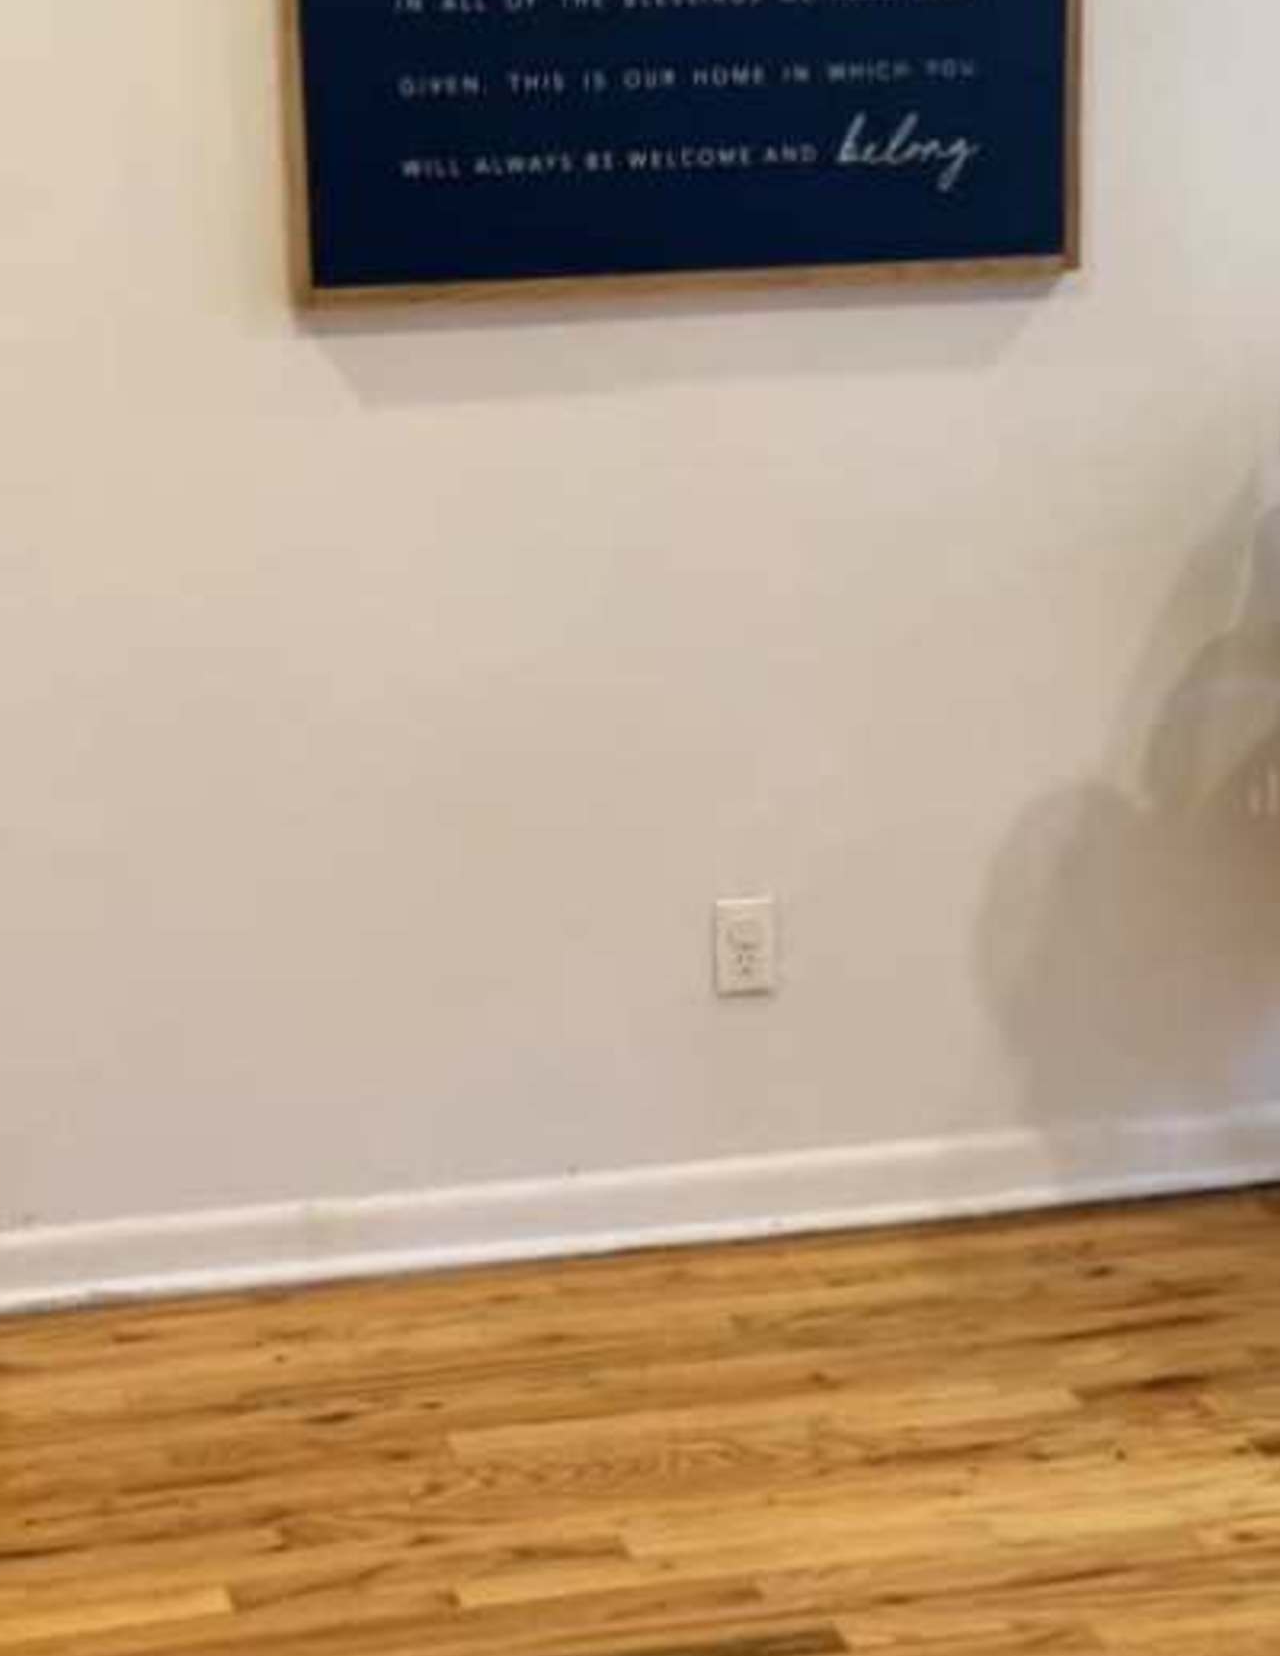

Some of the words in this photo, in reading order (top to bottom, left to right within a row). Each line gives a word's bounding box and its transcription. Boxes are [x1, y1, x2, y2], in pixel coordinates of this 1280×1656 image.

[508, 70, 565, 93] THIS
[582, 70, 607, 92] IS
[623, 68, 676, 90] OUR
[692, 65, 765, 87] HOME
[782, 64, 810, 82] IN
[827, 60, 910, 82] WHICH
[924, 57, 975, 80] YOU
[401, 159, 459, 178] WILL
[474, 152, 573, 176] ALWAYS
[584, 150, 613, 172] BE
[627, 146, 750, 170] WELCOME
[762, 143, 817, 163] AND
[835, 112, 979, 192] belong
